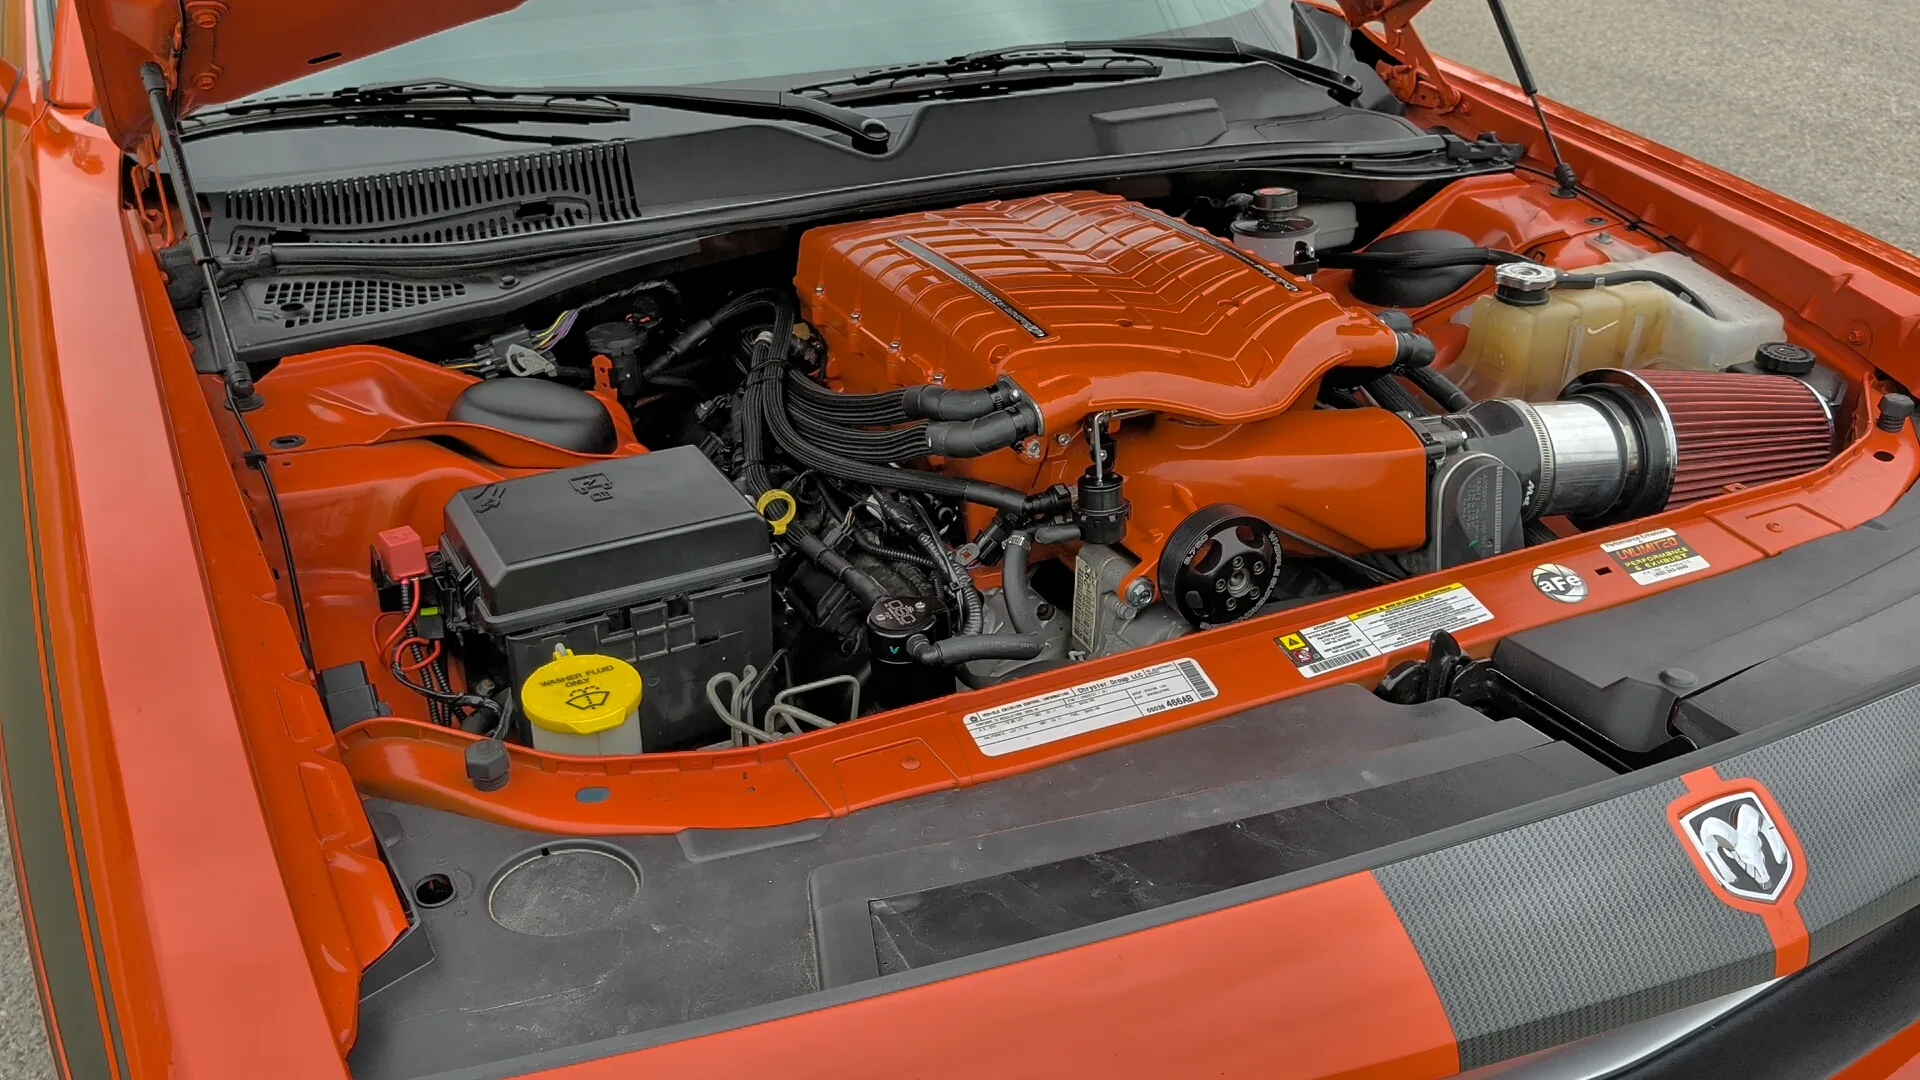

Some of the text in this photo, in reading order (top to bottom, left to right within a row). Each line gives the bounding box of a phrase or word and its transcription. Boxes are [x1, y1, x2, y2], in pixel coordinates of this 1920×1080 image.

[954, 272, 999, 305] PERFORMANCE
[1615, 537, 1679, 560] UNLIMITED
[1624, 546, 1689, 568] PERFORMANCE
[1644, 553, 1688, 569] EXHAUST
[1538, 575, 1583, 592] aFe
[1313, 621, 1337, 630] ATTENTION
[540, 664, 615, 687] WASHER FLUID
[564, 677, 590, 688] ONLY
[1077, 682, 1107, 693] Chrysler
[1110, 676, 1130, 686] Group
[1131, 672, 1144, 680] LLC
[982, 709, 1001, 718] VEHICLE
[1001, 703, 1022, 714] EMISSION
[1023, 699, 1041, 709] CONTROL
[1043, 691, 1069, 701] INFORMATION
[1146, 694, 1194, 714] 05038 466AB
